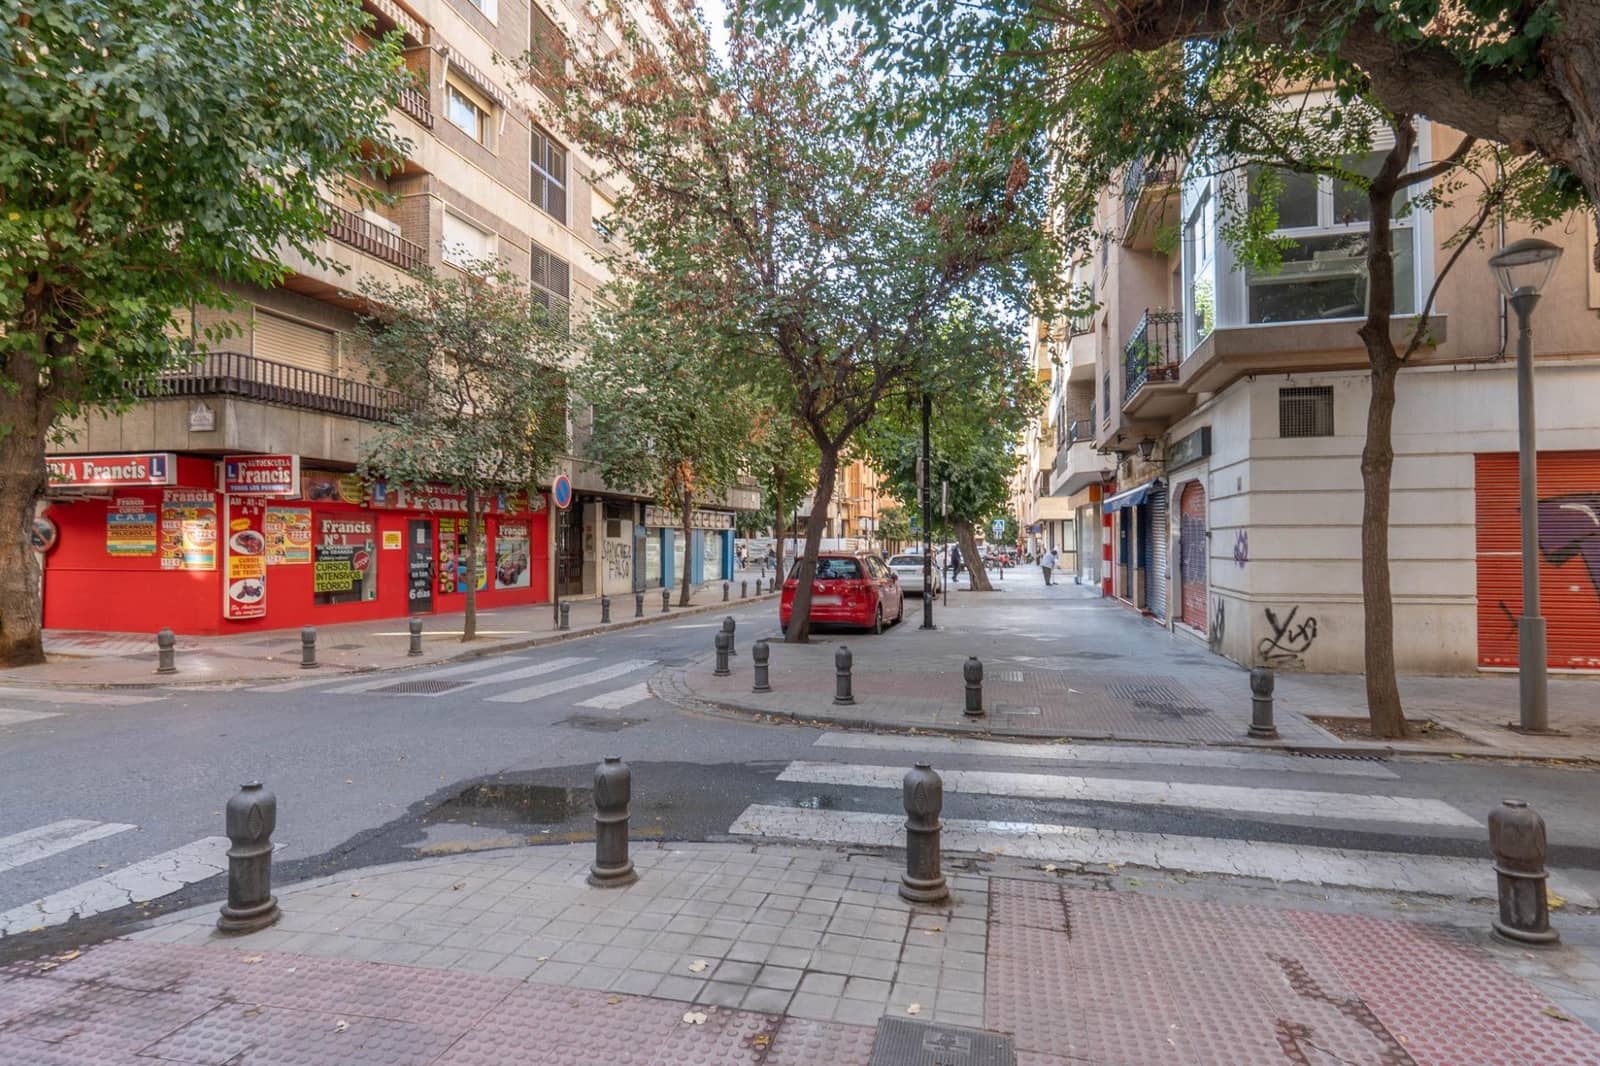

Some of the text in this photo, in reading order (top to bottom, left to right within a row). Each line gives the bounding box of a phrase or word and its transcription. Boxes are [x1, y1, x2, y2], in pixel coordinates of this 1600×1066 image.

[83, 461, 146, 480] Francis
[238, 462, 290, 483] Francis
[163, 490, 215, 502] Francis
[321, 520, 372, 533] Francis
[316, 562, 349, 572] CURSOS
[316, 571, 361, 581] INTENSIVOS
[409, 589, 417, 600] 6
